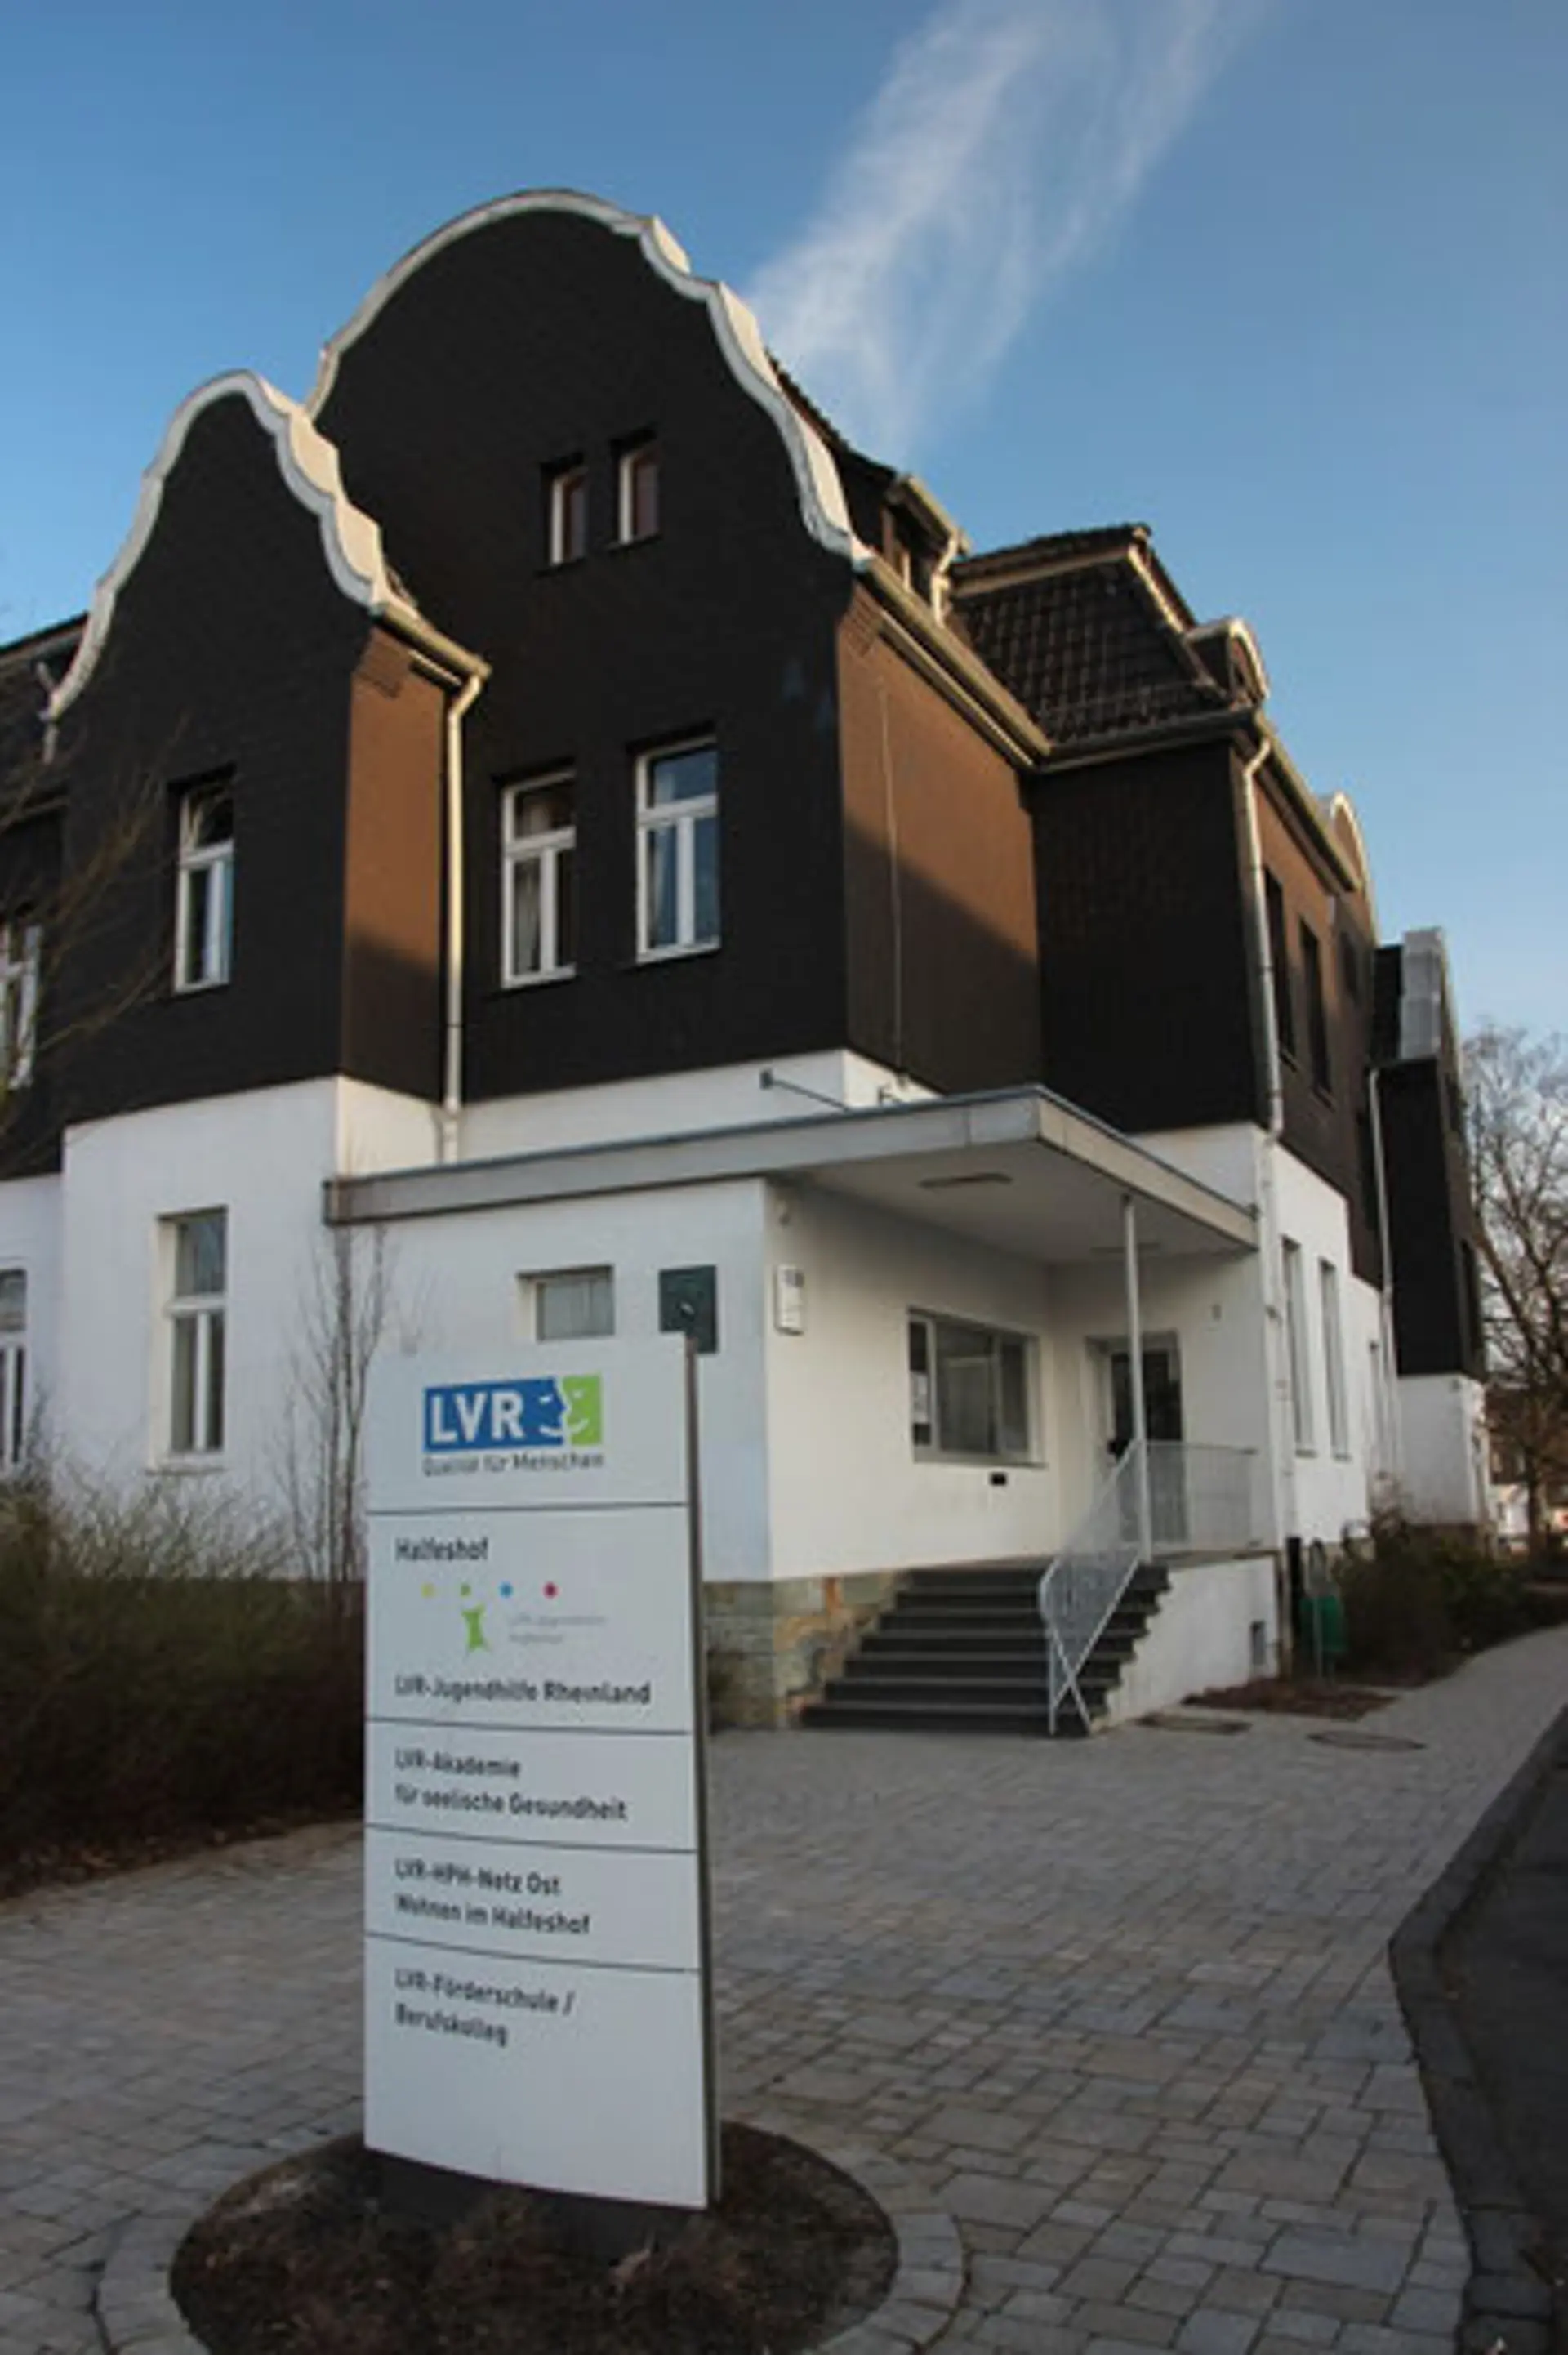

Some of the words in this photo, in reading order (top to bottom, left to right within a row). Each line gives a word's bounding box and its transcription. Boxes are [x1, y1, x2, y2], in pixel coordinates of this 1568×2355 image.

[430, 1391, 523, 1444] LVR
[544, 1679, 651, 1705] Rheinland
[509, 1792, 626, 1821] Gesundheit
[527, 1871, 561, 1895] Ost
